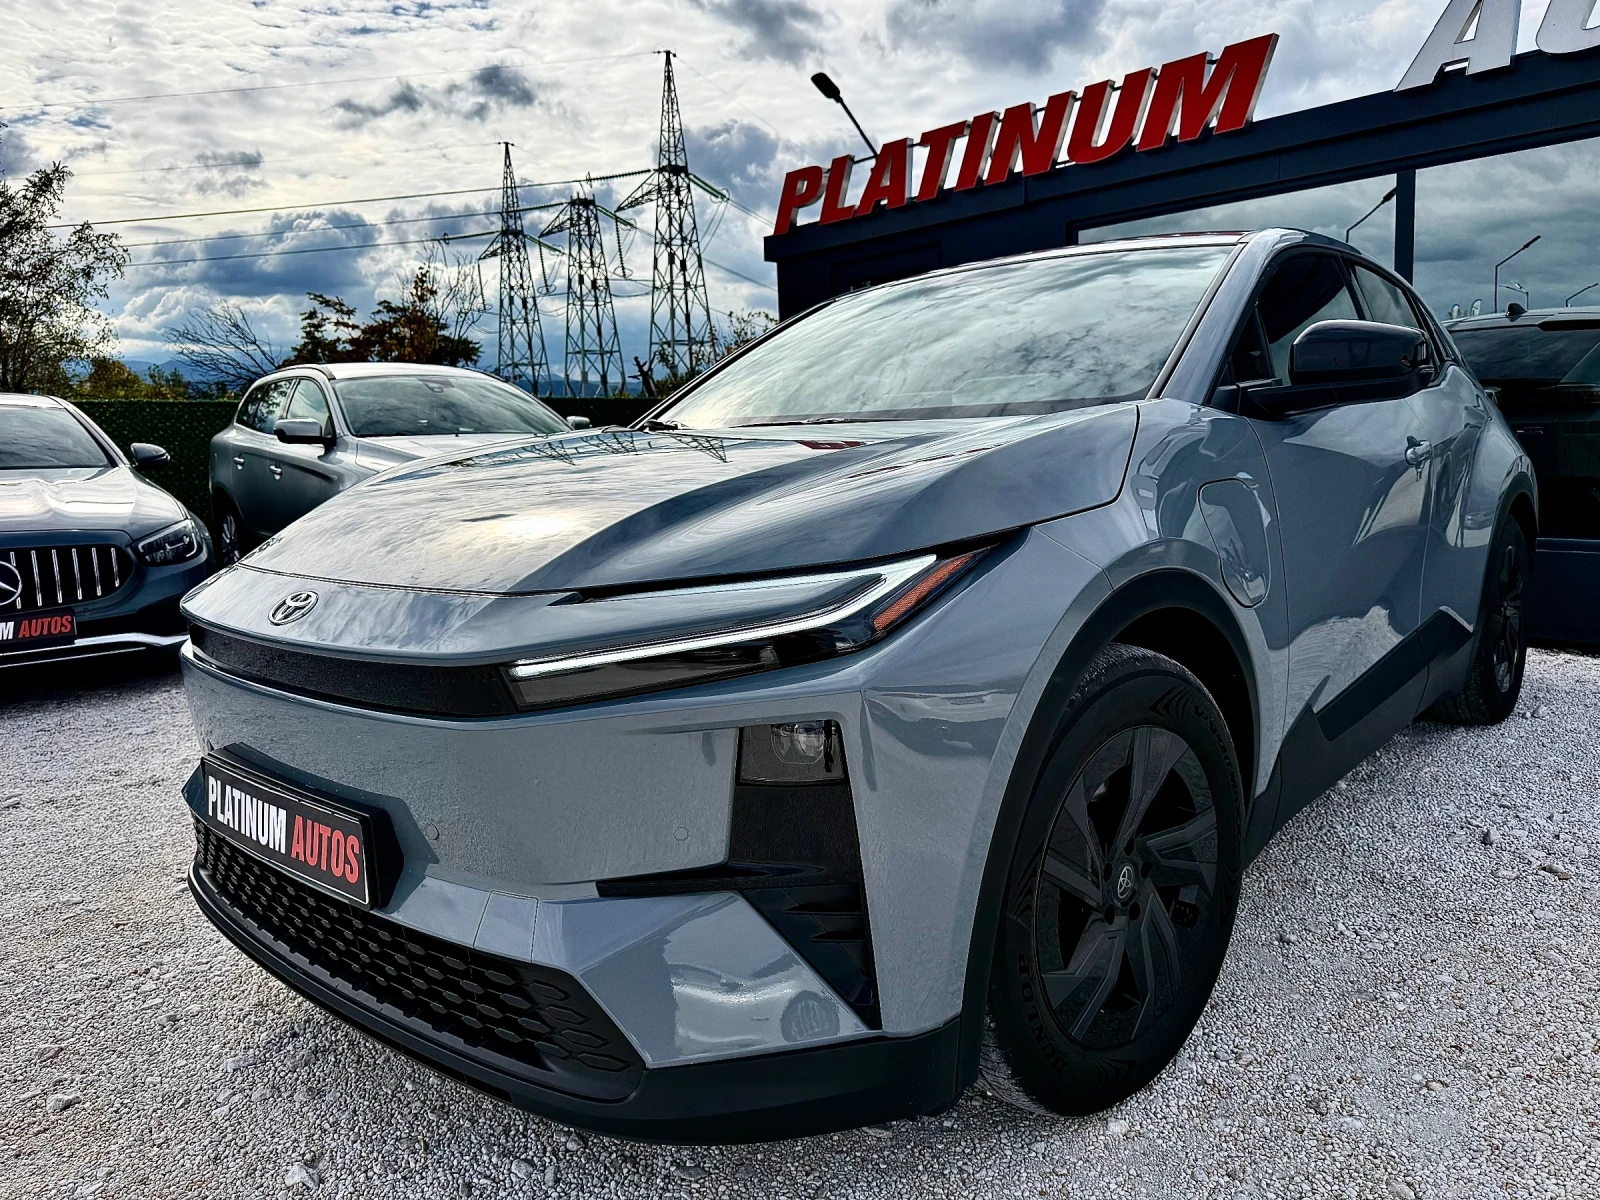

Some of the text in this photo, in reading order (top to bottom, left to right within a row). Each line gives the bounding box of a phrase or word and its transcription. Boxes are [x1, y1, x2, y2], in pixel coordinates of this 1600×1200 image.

[774, 33, 1279, 236] PLATINUM
[18, 615, 72, 638] AUTOS
[208, 776, 360, 883] PLATINUM AUTOS
[1018, 953, 1067, 1073] DUNLOP
